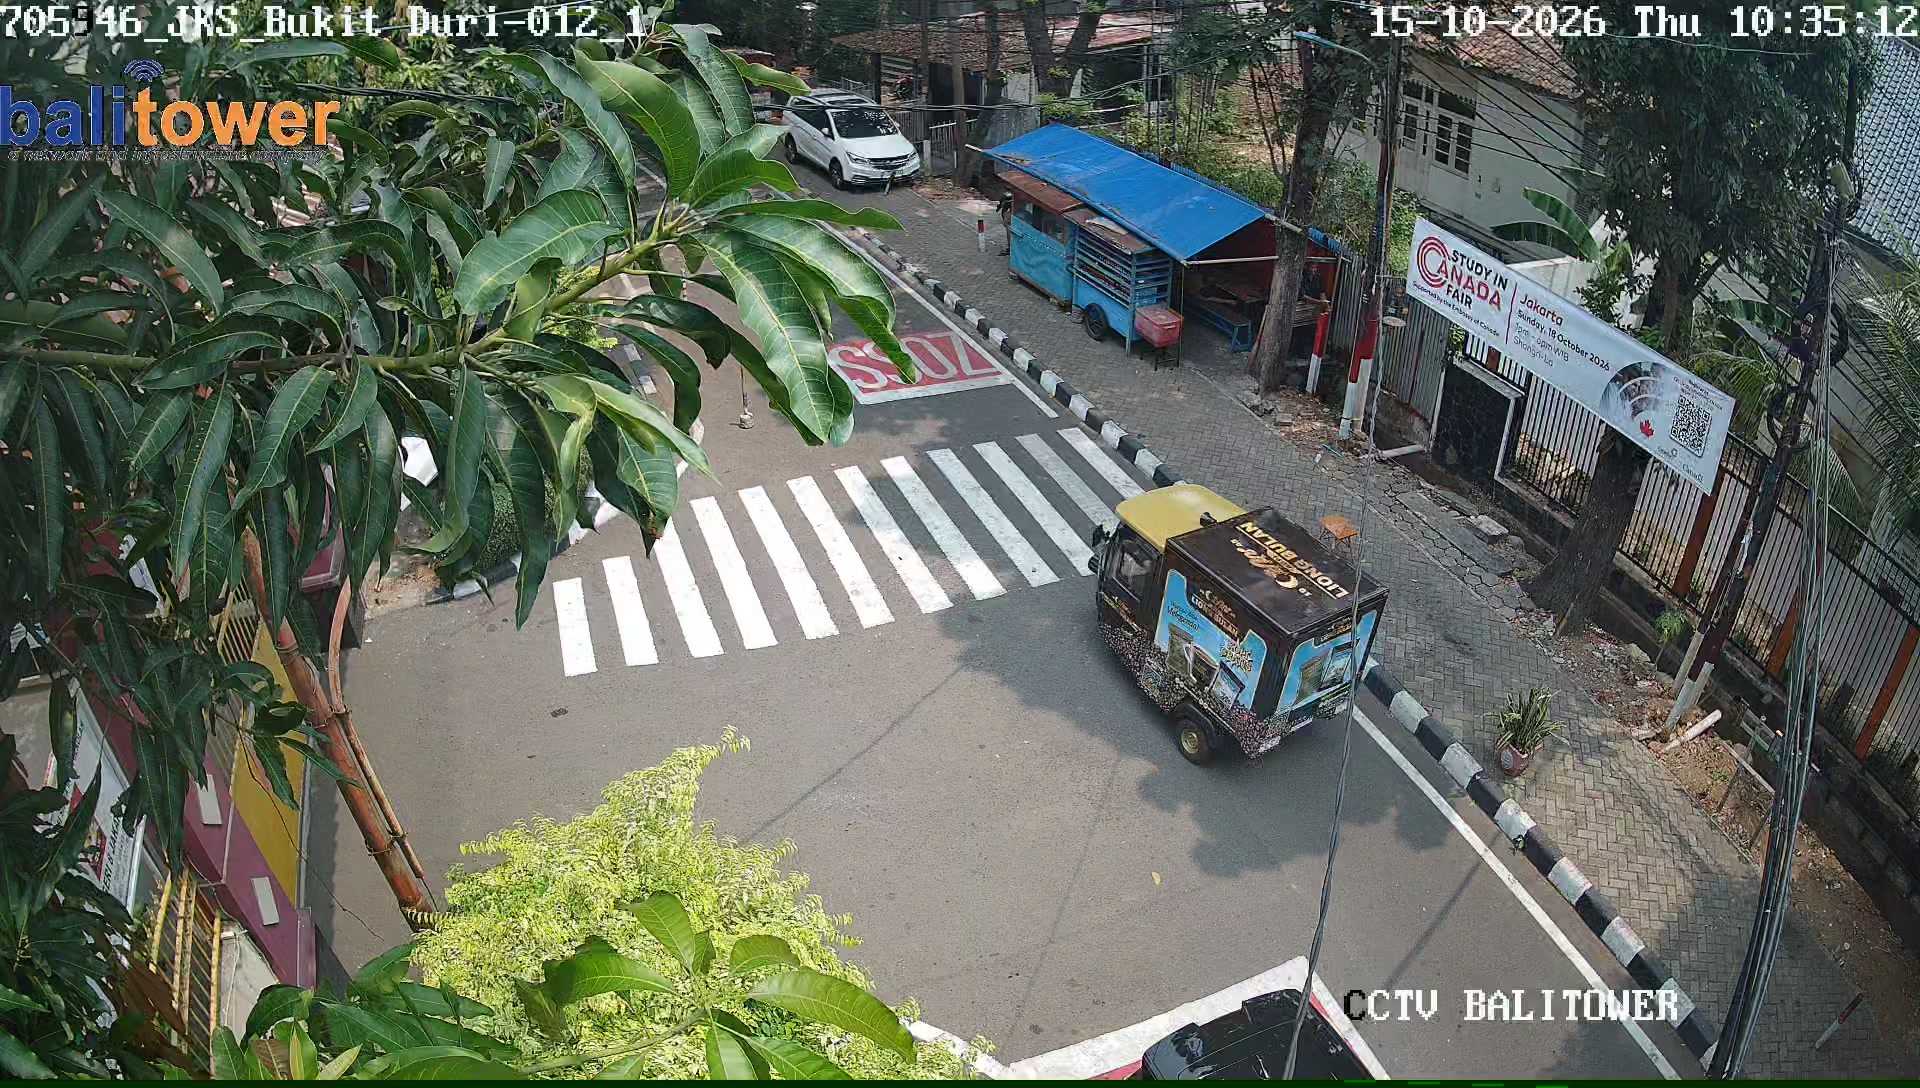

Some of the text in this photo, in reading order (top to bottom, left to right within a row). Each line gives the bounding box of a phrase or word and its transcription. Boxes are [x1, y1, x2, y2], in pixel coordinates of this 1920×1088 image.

[1416, 236, 1502, 312] CANADA
[1451, 249, 1508, 291] STUDY IN
[1446, 284, 1473, 310] FAIR
[1519, 294, 1563, 327] Jakarta
[1517, 309, 1610, 371] Sunday, 18 October 2026
[1240, 521, 1299, 561] BULAN
[1294, 558, 1350, 599] LIONG
